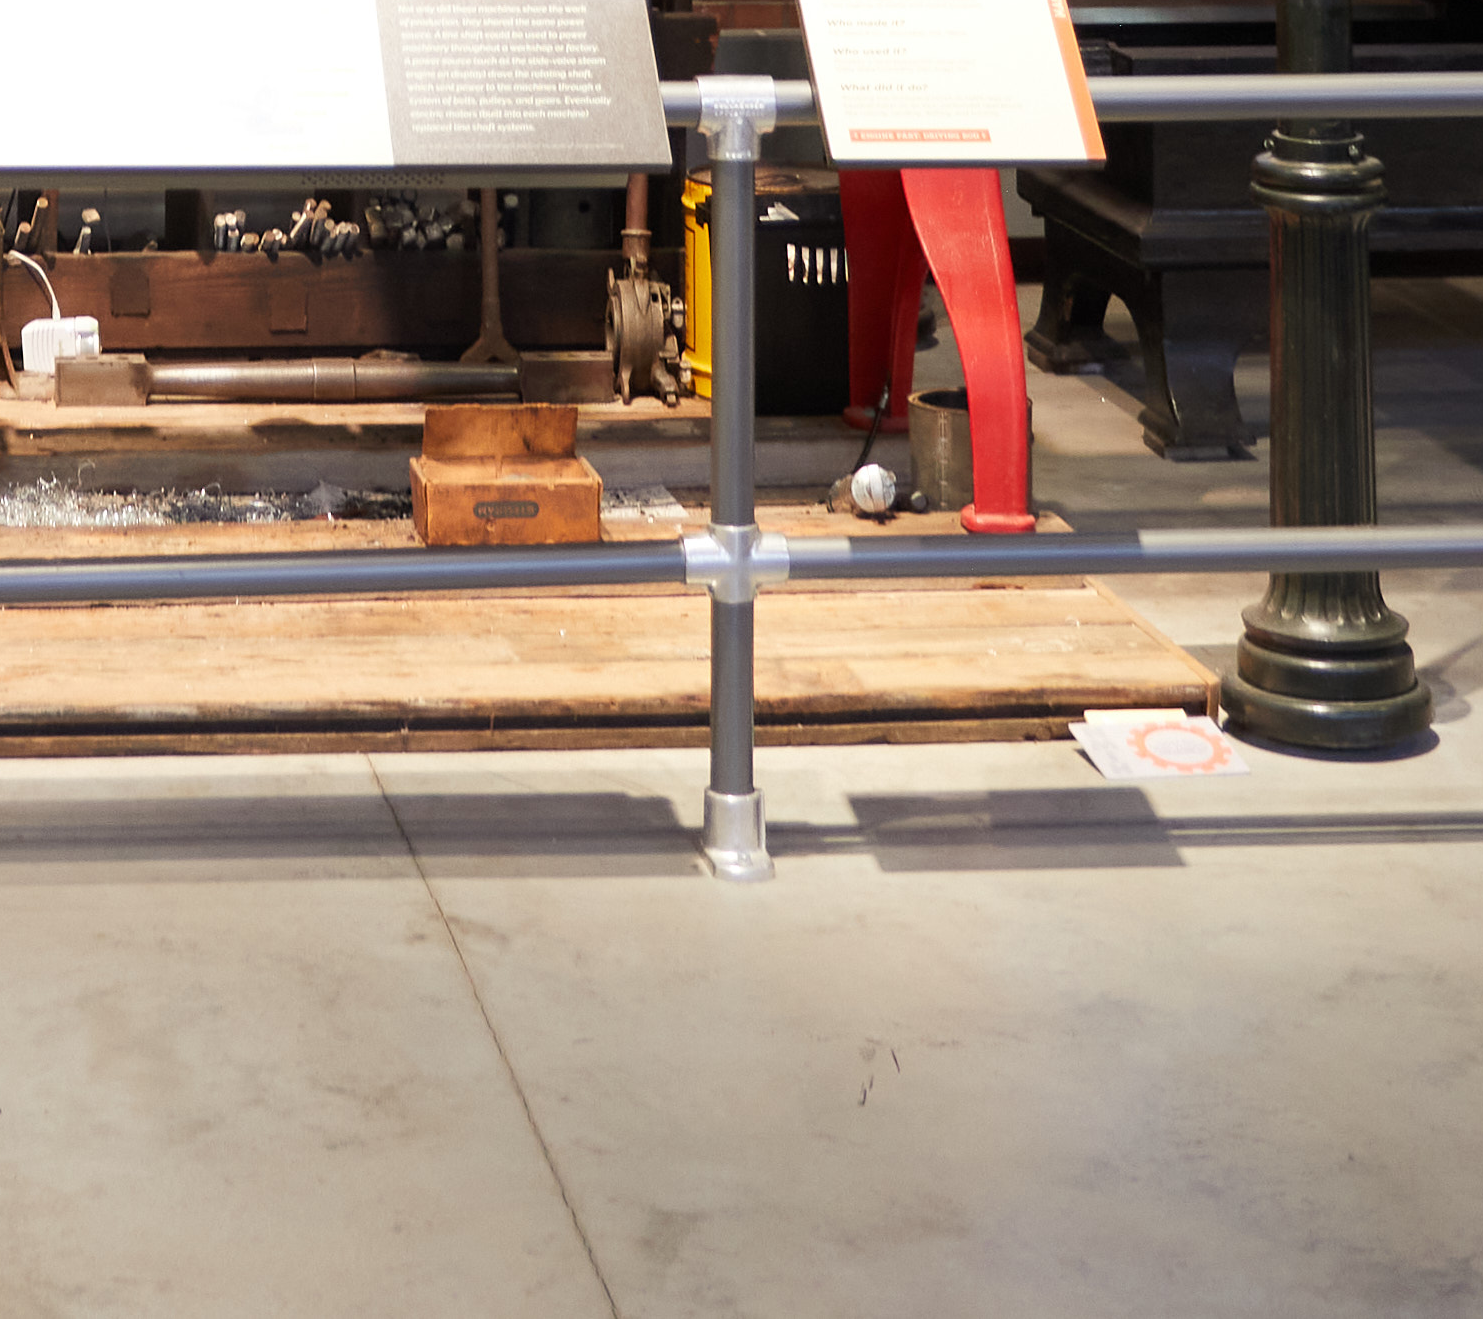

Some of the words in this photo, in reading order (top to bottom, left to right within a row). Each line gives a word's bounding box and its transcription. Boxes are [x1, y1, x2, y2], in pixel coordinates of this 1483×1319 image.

[827, 19, 853, 27] Who
[855, 19, 889, 27] made
[890, 19, 906, 27] it?
[832, 47, 860, 56] Who
[862, 47, 890, 56] used
[893, 47, 908, 56] it?
[840, 83, 872, 92] What
[874, 83, 894, 92] did
[896, 83, 905, 92] it
[907, 83, 929, 92] do?
